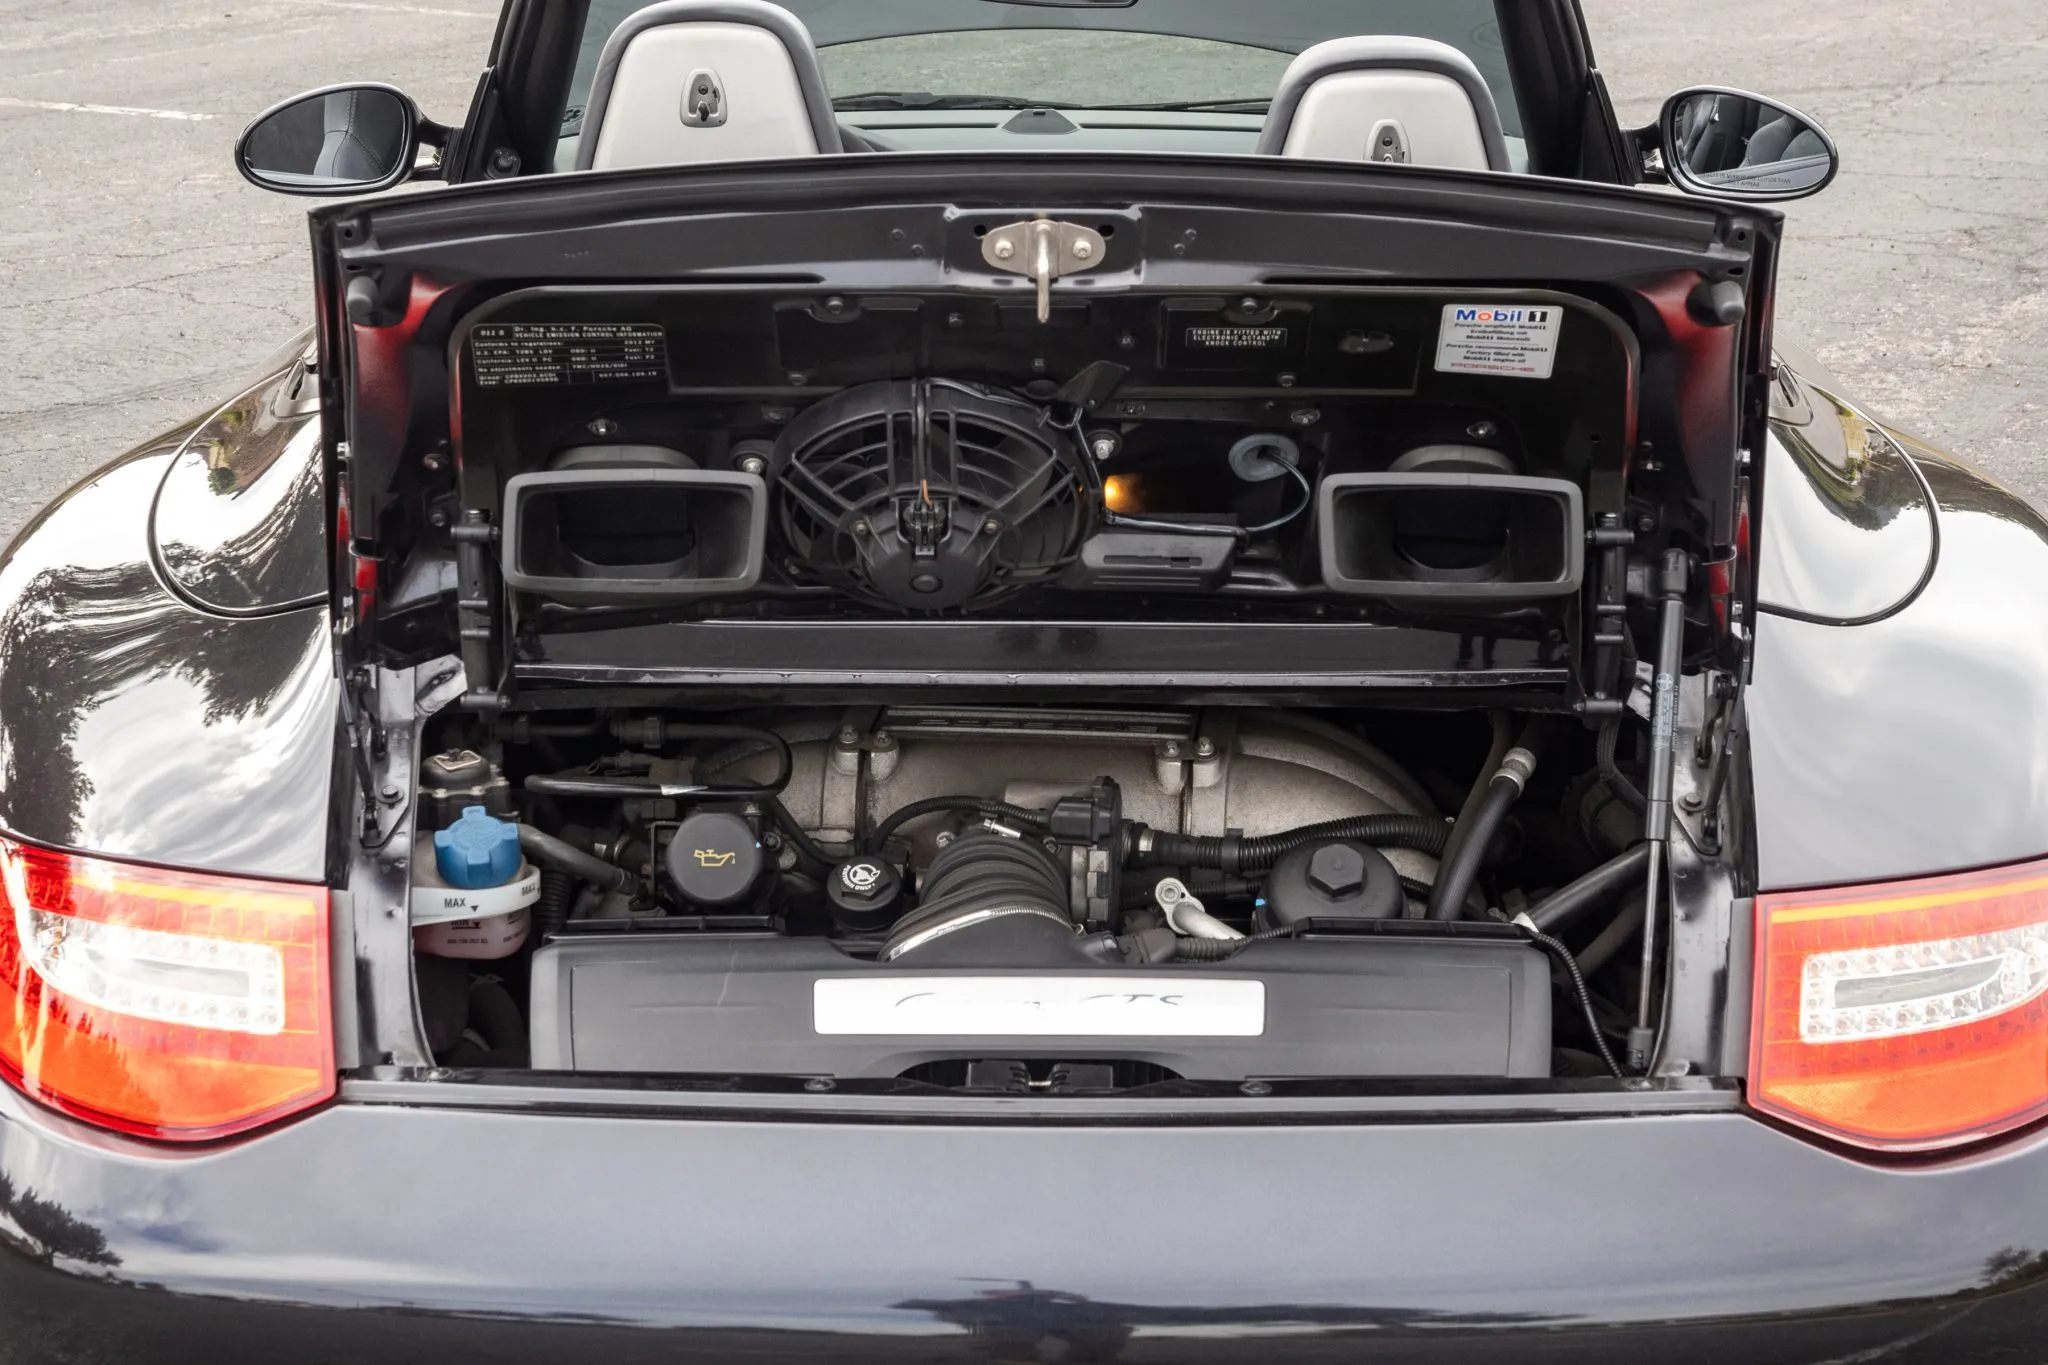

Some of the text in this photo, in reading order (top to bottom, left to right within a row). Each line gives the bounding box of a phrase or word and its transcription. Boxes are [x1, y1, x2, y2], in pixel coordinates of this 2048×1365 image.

[1456, 309, 1521, 322] Mobil
[1450, 362, 1535, 372] PORSCHE
[521, 884, 536, 896] MAX
[444, 897, 466, 908] MAX
